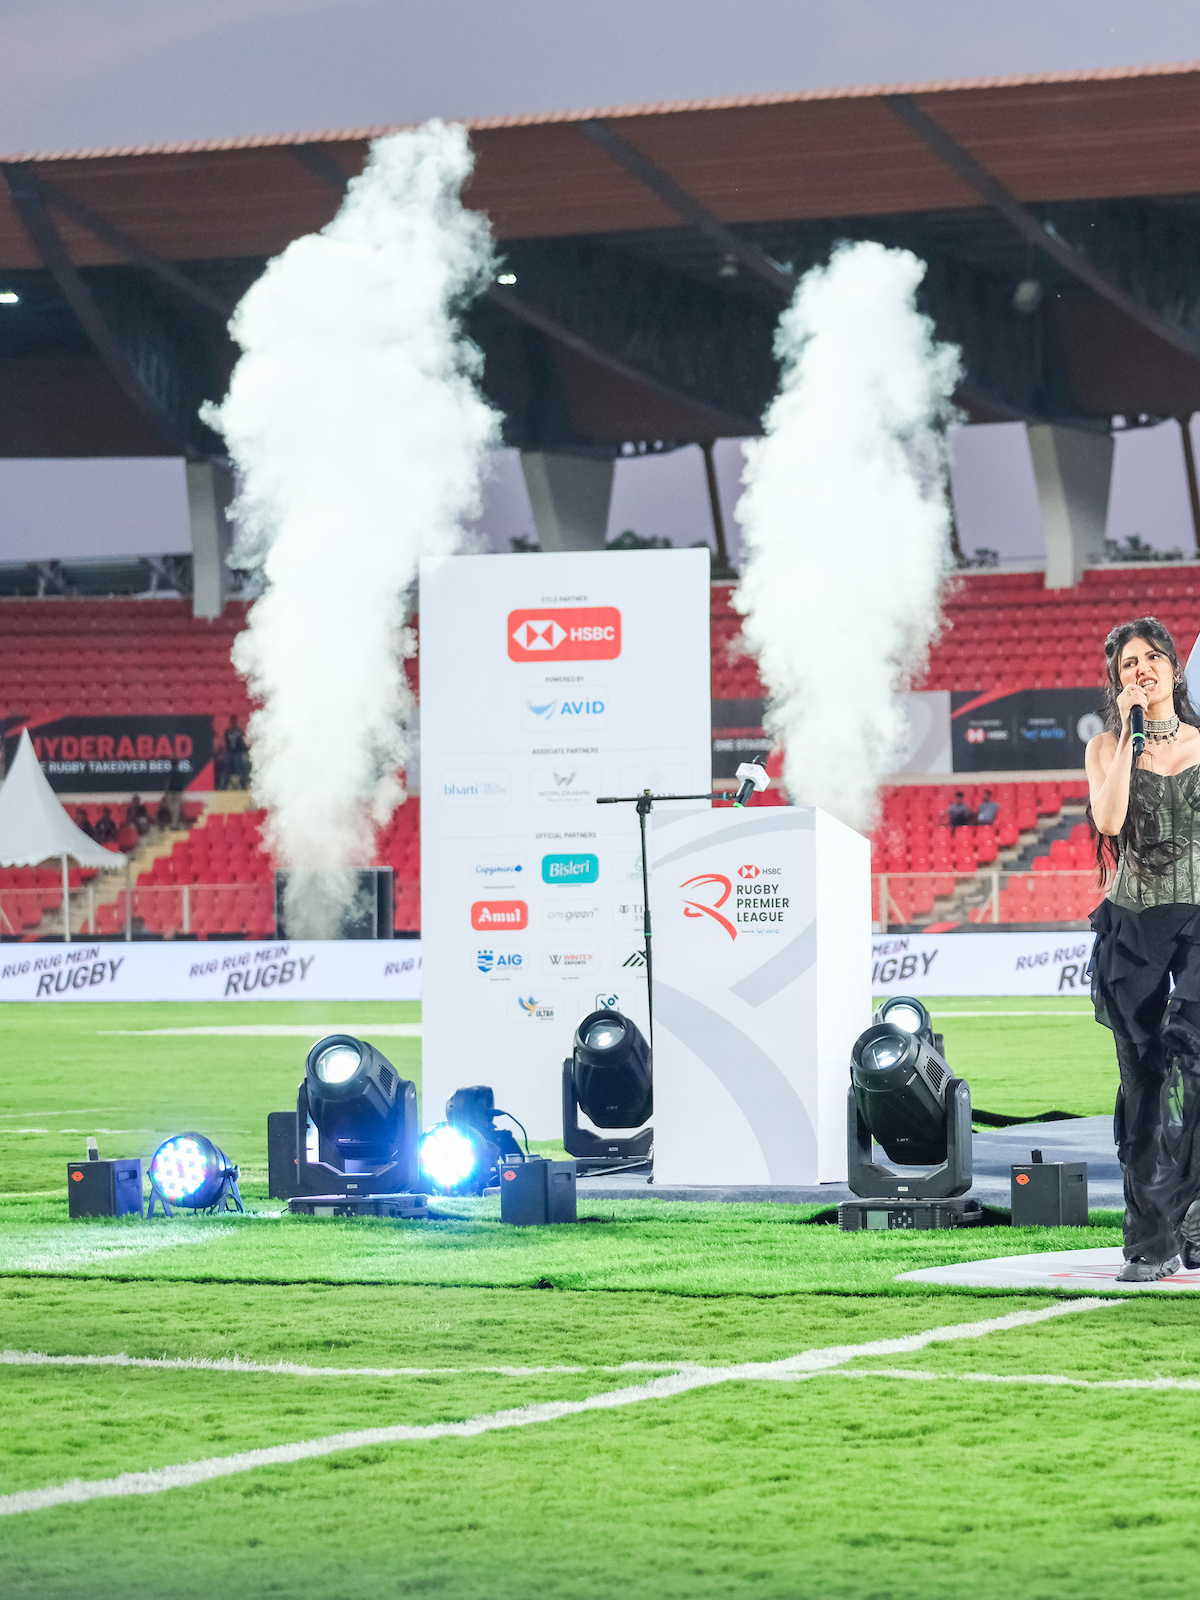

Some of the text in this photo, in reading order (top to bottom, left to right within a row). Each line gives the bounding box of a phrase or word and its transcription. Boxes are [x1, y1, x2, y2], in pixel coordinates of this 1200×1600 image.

[570, 626, 615, 641] HSBC
[532, 746, 599, 755] ASSOCIATE PARTNERS
[48, 760, 86, 774] RUGBY
[88, 760, 147, 773] TAKEOVER
[444, 783, 478, 795] bharti
[475, 865, 515, 876] Capgemini
[549, 860, 590, 878] Bisleri
[736, 884, 779, 895] RUGBY
[736, 898, 790, 908] PREMIER
[478, 907, 522, 924] Amul
[565, 909, 594, 921] green
[737, 912, 784, 922] LEAGUE
[1, 945, 100, 979] RUG RUG MEIN
[189, 945, 290, 978] RUG RUG MEIN
[497, 954, 523, 966] AIG
[1016, 944, 1087, 971] RUG RUG
[384, 957, 415, 976] RUG
[36, 956, 124, 998] RUGBY
[224, 955, 315, 997] RUGBY
